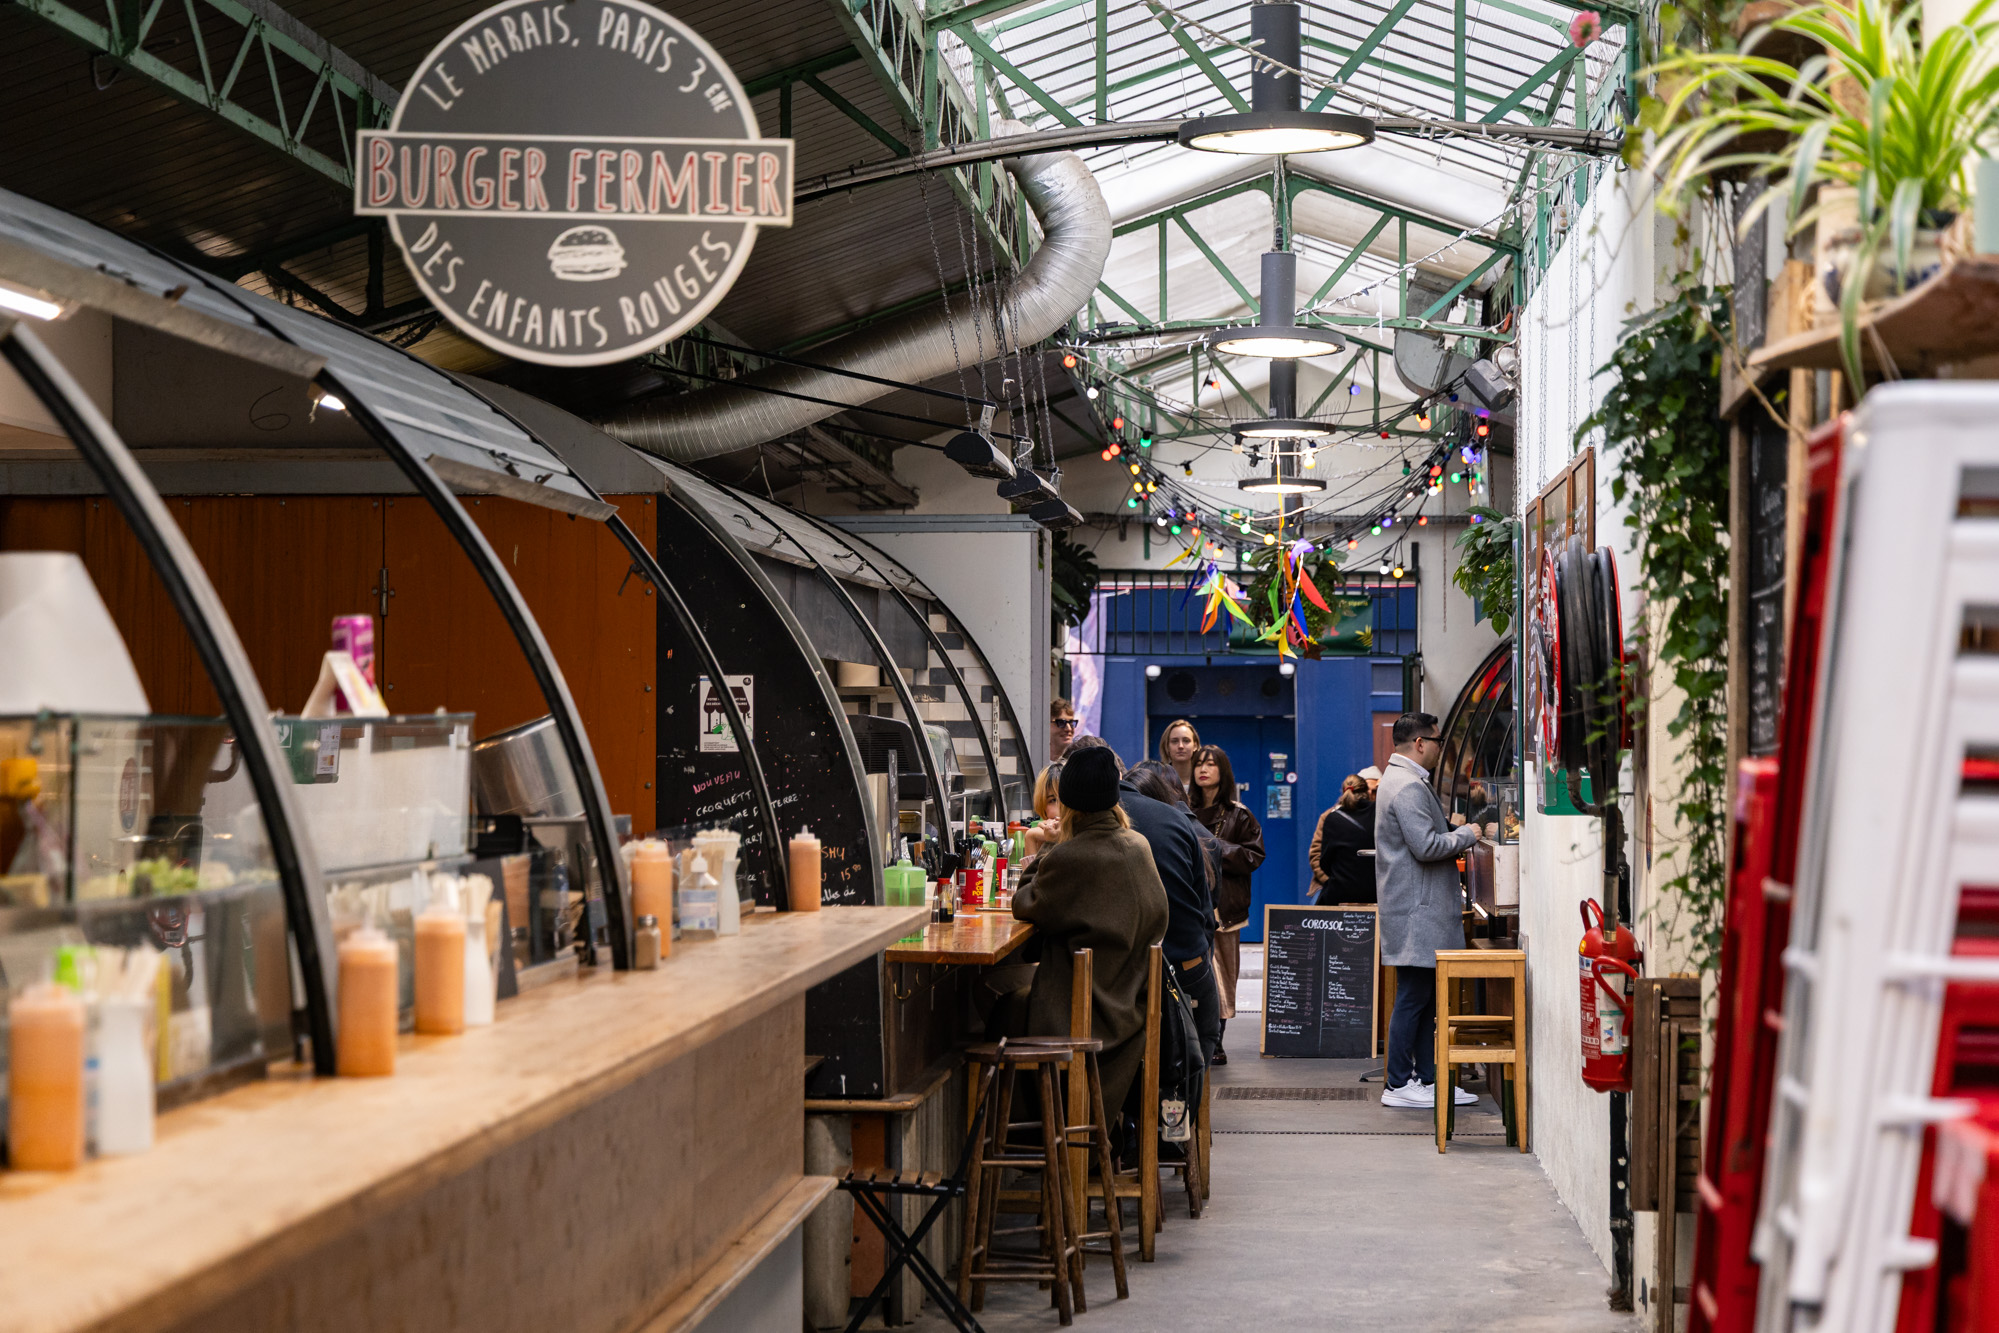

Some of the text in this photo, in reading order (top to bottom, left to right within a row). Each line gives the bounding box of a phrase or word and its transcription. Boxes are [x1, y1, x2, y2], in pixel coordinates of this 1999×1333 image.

[421, 62, 464, 111] LE
[597, 6, 679, 74] PARIS
[367, 137, 785, 217] BURGER FERMIER
[410, 221, 732, 349] DES ENFANTS ROUGES
[693, 768, 741, 794] NOUVEAU
[695, 789, 755, 817] CROQUETT
[769, 792, 800, 809] TERRE
